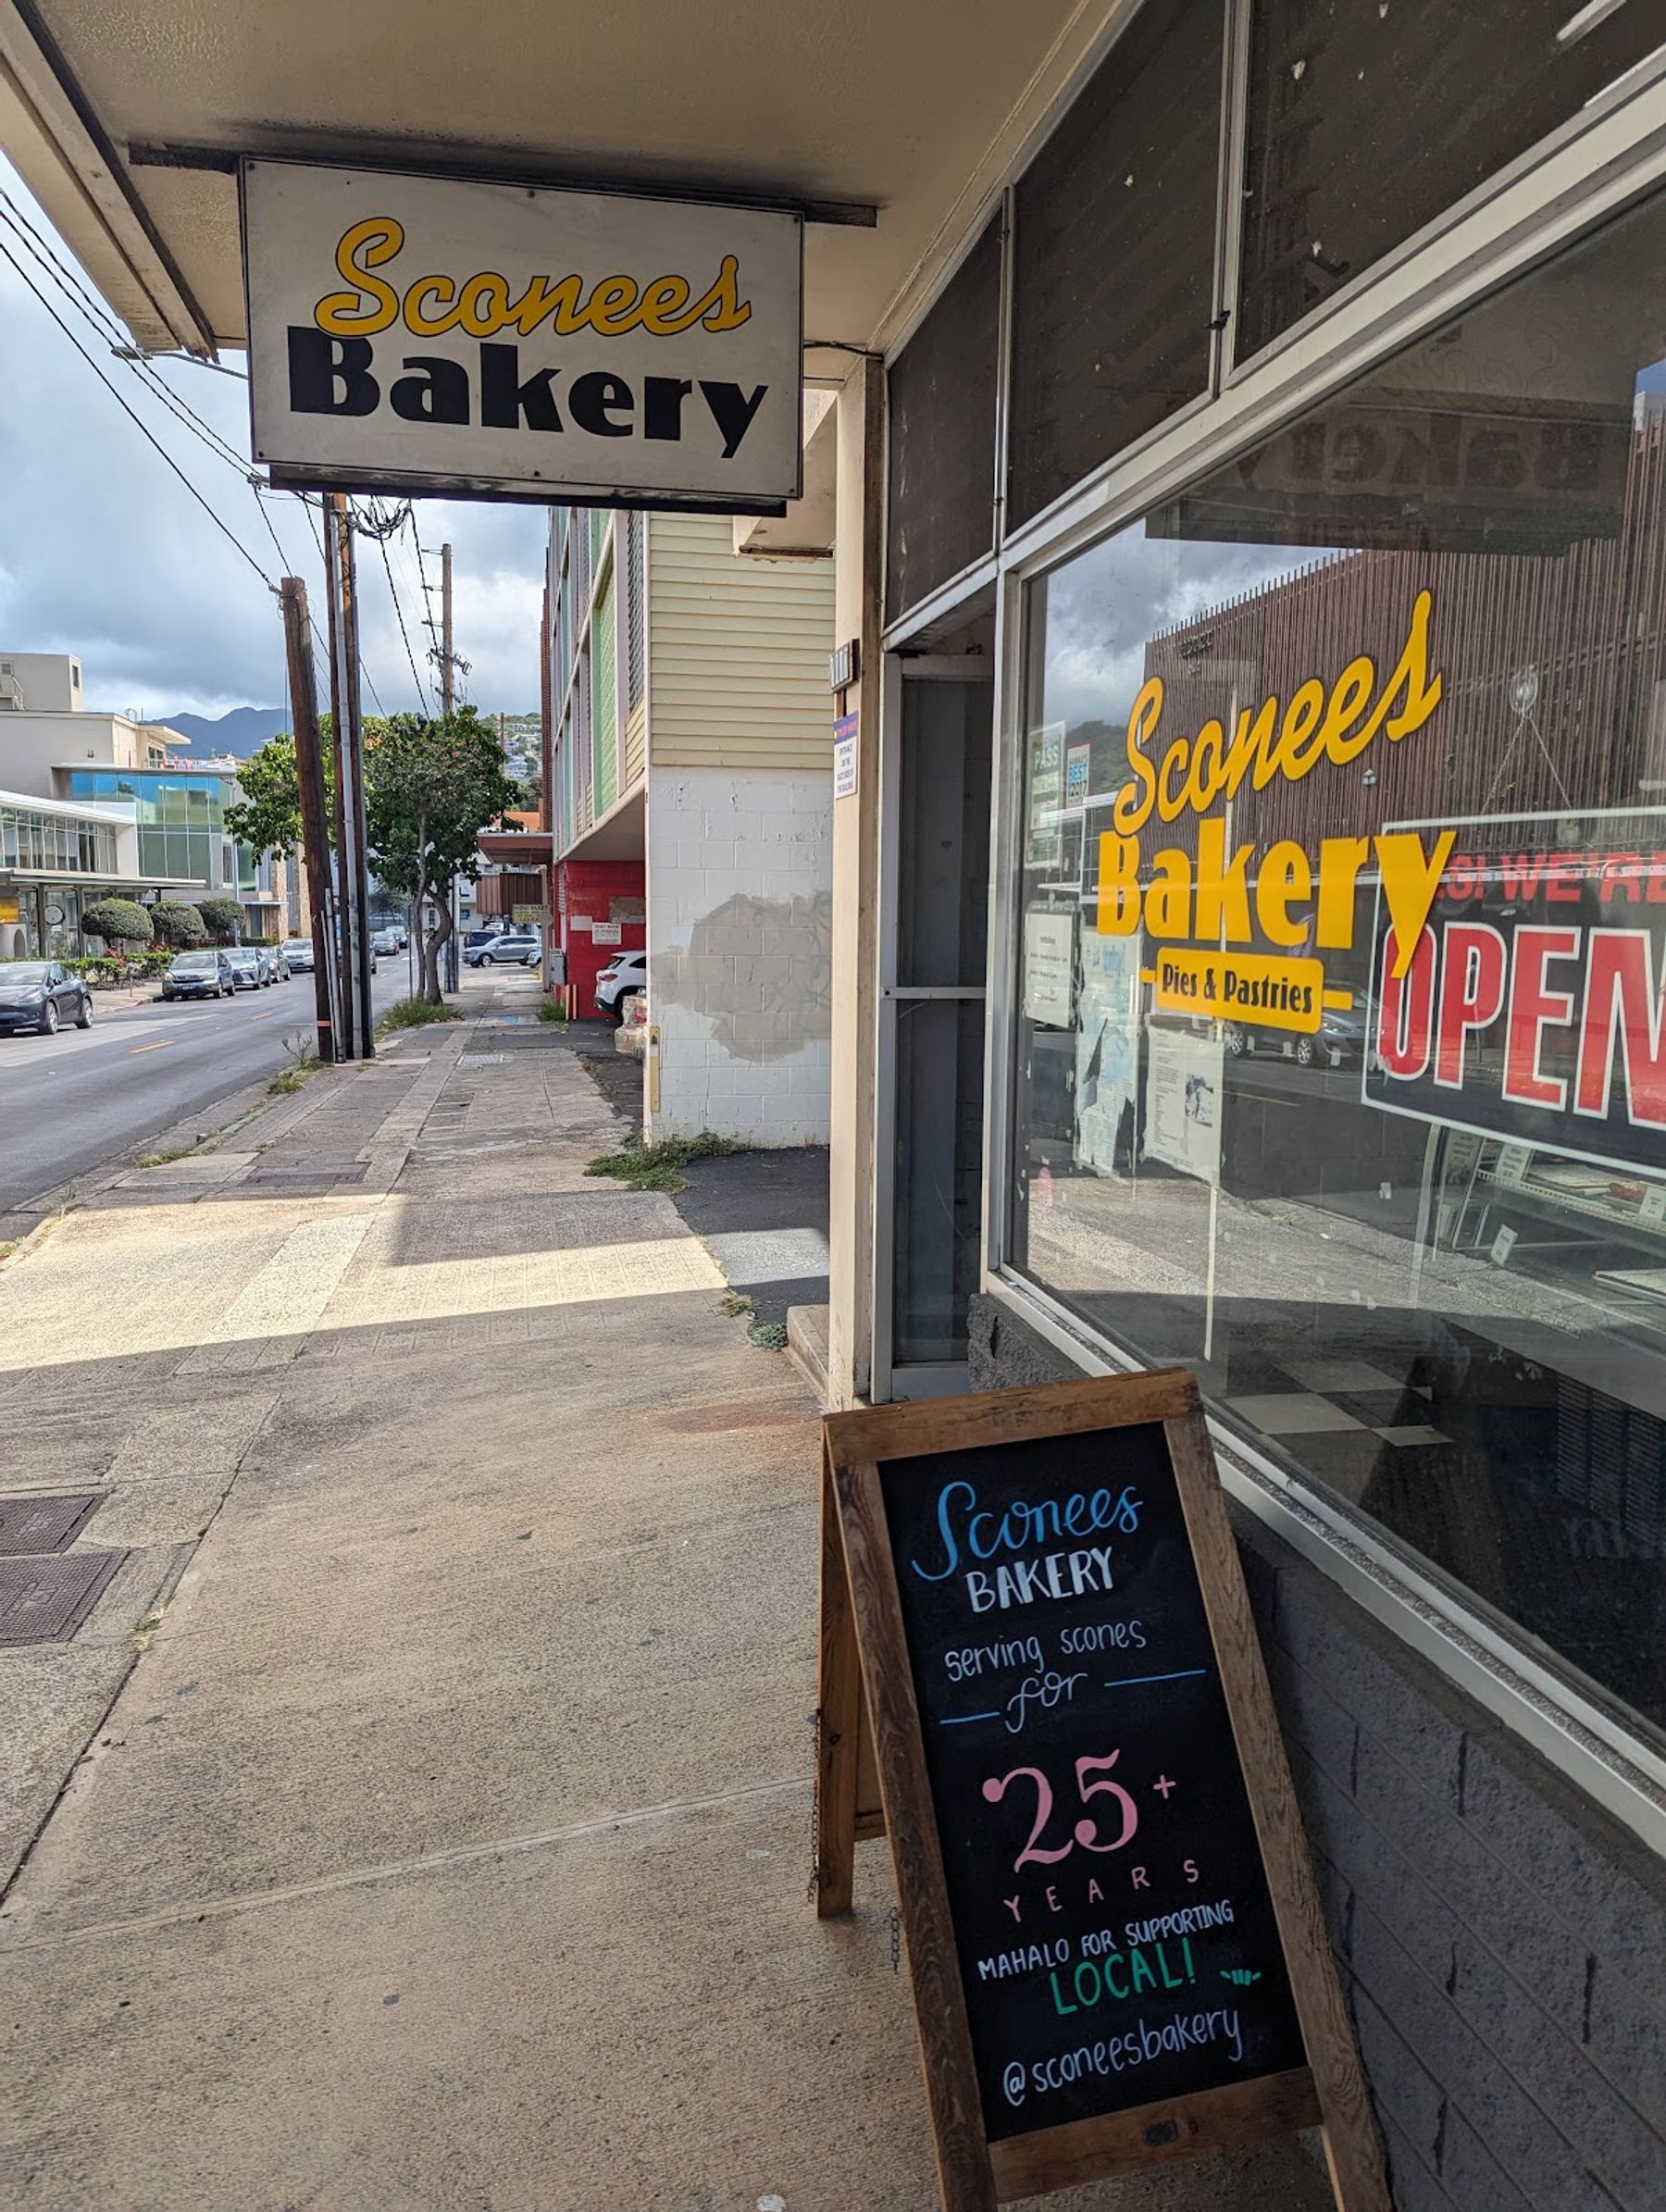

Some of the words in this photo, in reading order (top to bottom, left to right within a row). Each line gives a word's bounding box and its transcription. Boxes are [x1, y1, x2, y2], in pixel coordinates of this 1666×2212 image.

[314, 217, 752, 337] Sconees
[287, 325, 768, 458] Bakery
[1113, 589, 1443, 837] Sconees
[1034, 744, 1060, 771] PASS
[1069, 764, 1087, 780] BEST
[1097, 817, 1457, 979] Bakery
[1162, 963, 1197, 998] Pies
[1203, 968, 1217, 1001] &
[1224, 970, 1312, 1014] Pastries
[1376, 921, 1666, 1131] OPEN
[912, 1480, 1144, 1581] Sconees
[964, 1546, 1114, 1613] BAKERY
[944, 1634, 1044, 1683] serving
[1060, 1620, 1148, 1655] scones
[1004, 1671, 1088, 1734] for
[977, 1938, 1071, 1982] MAHALO
[1081, 1929, 1117, 1957] FOR
[1125, 1899, 1236, 1947] SUPPORTING
[1050, 1936, 1197, 2016] LOCAL!
[1002, 2007, 1243, 2107] @sconeesbakery
